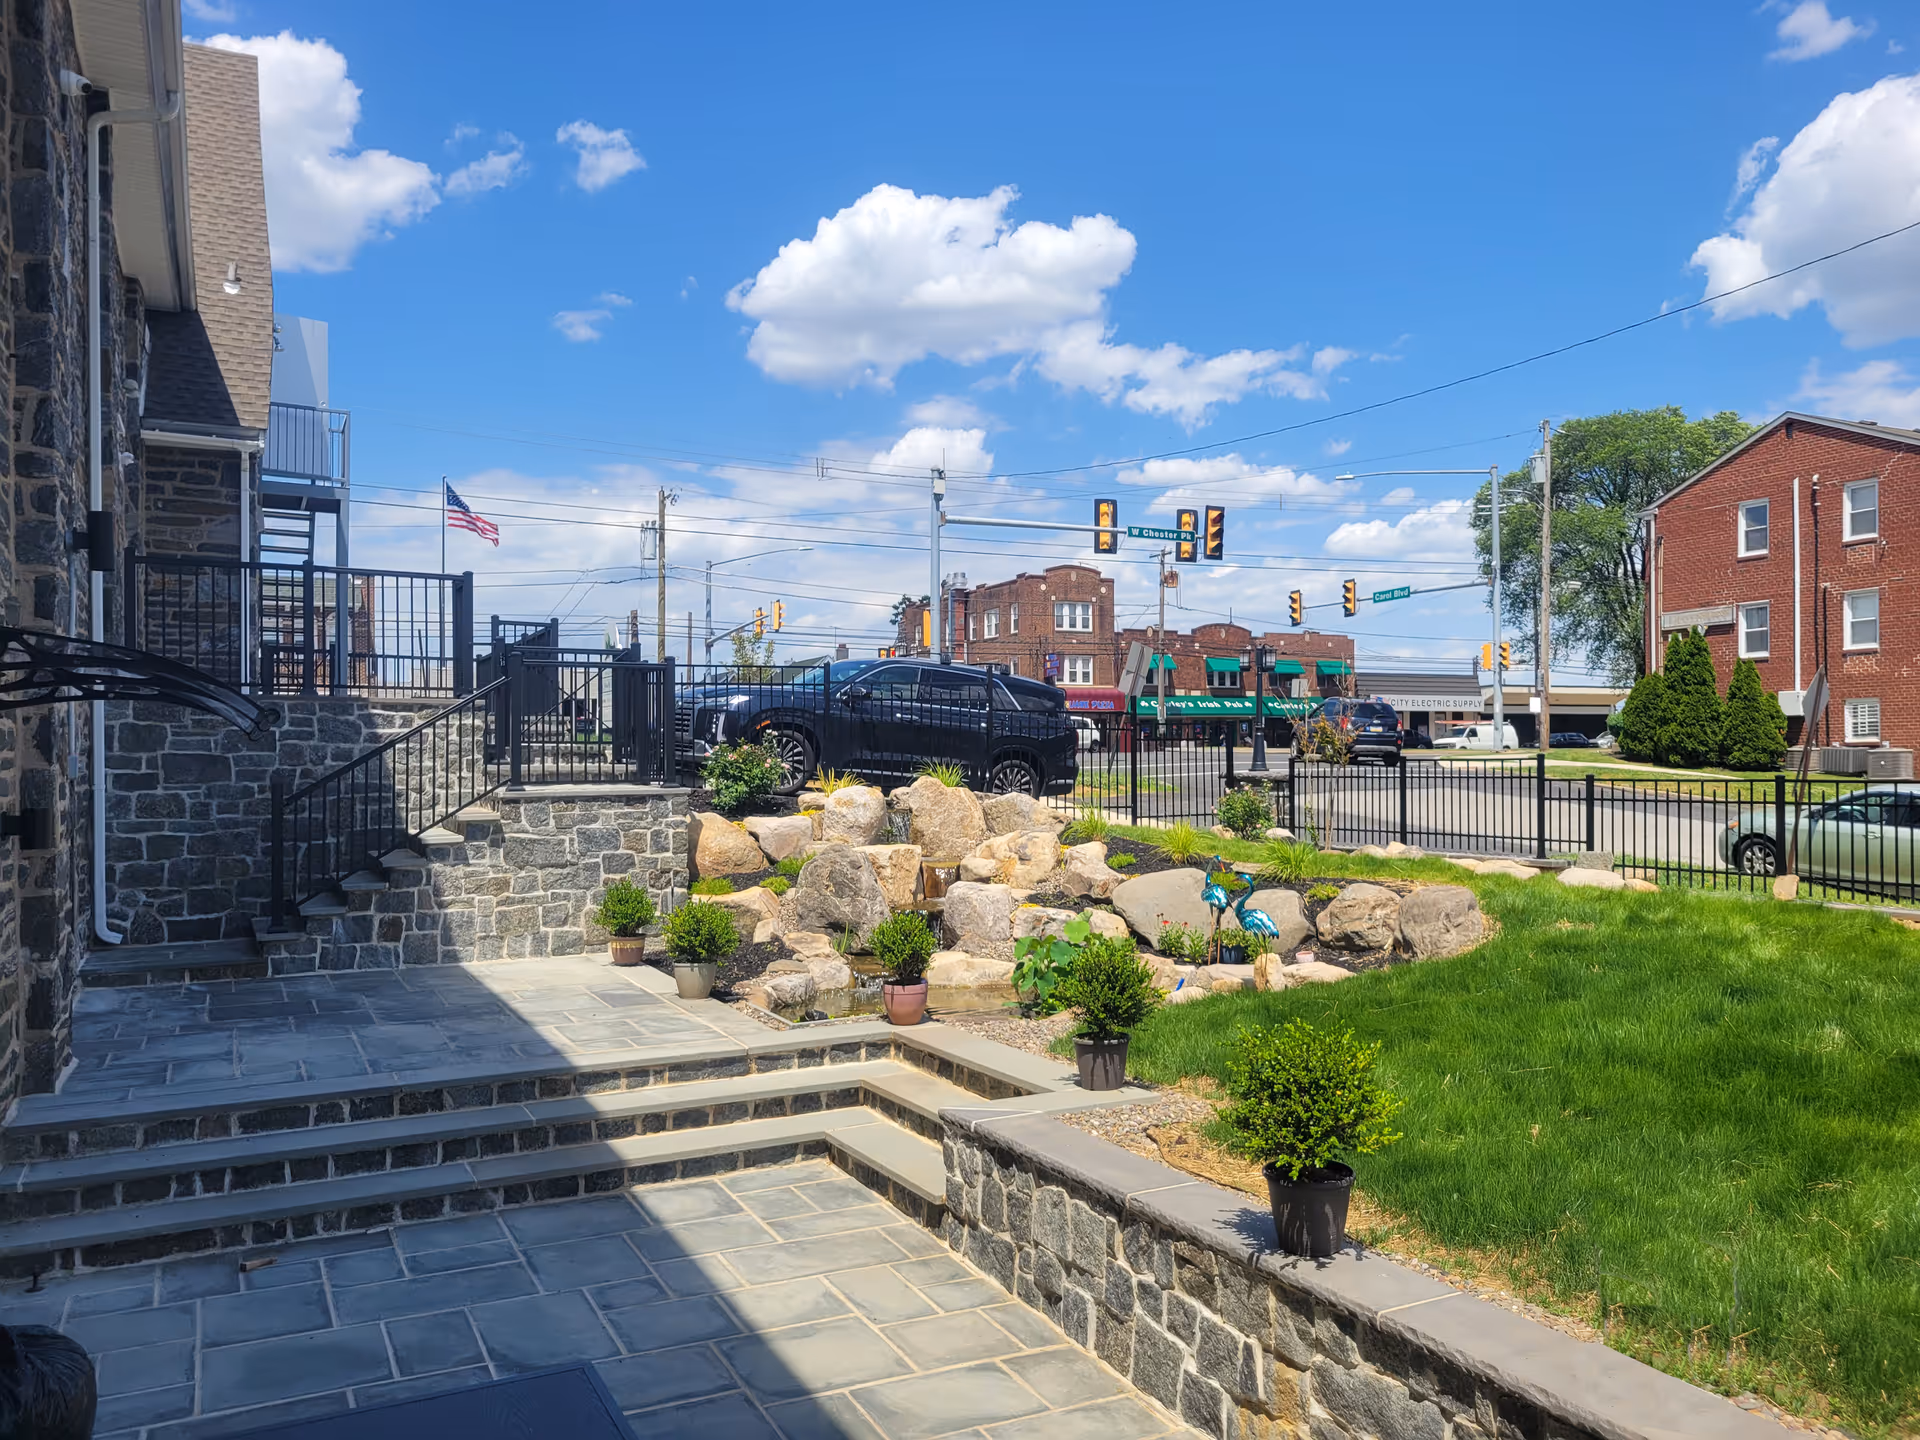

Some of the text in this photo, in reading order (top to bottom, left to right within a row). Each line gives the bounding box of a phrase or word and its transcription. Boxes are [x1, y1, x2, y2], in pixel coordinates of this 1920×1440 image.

[1131, 527, 1191, 540] W Chester Pk
[1375, 589, 1408, 601] Carol Blvd
[1197, 700, 1222, 708] Irish
[1223, 700, 1244, 708] Pub
[1390, 698, 1482, 708] CITY ELECTRIC SUPPLY
